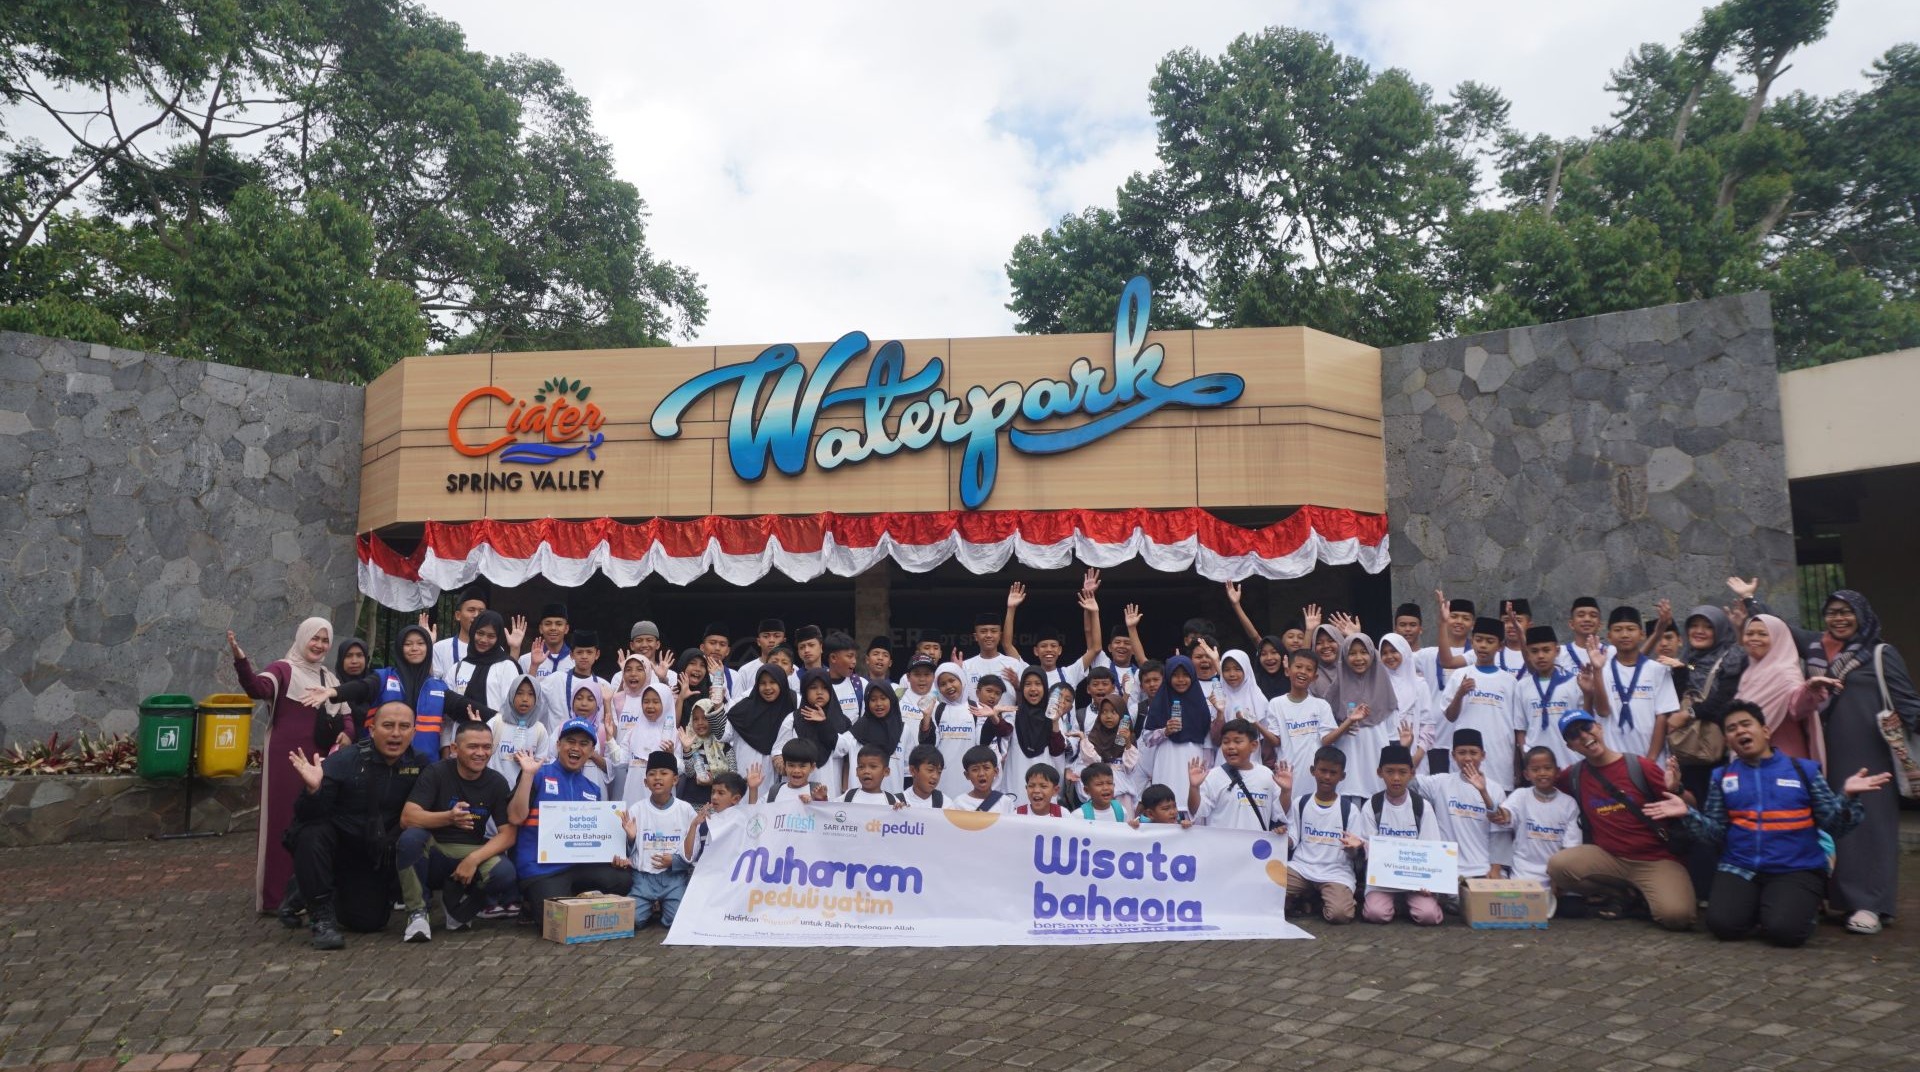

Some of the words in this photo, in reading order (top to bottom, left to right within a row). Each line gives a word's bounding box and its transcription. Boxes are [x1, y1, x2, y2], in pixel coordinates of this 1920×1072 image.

[651, 274, 1245, 511] Waterpark
[448, 386, 605, 457] Ciater
[446, 471, 523, 493] SPRING
[530, 469, 604, 491] VALLEY
[787, 812, 816, 831] fresh
[823, 823, 838, 832] SARI
[840, 824, 858, 833] ATER
[865, 819, 924, 837] dtpeduli
[583, 833, 612, 841] Bahagia
[1034, 834, 1197, 882] Wisata
[730, 846, 923, 894] Muharram
[748, 886, 819, 913] peduli
[822, 890, 894, 919] yatim
[723, 912, 759, 922] Hadirkan
[800, 919, 823, 928] untuk
[824, 920, 842, 929] Raih
[844, 922, 892, 931] Pertolongan
[1034, 921, 1098, 929] bersama
